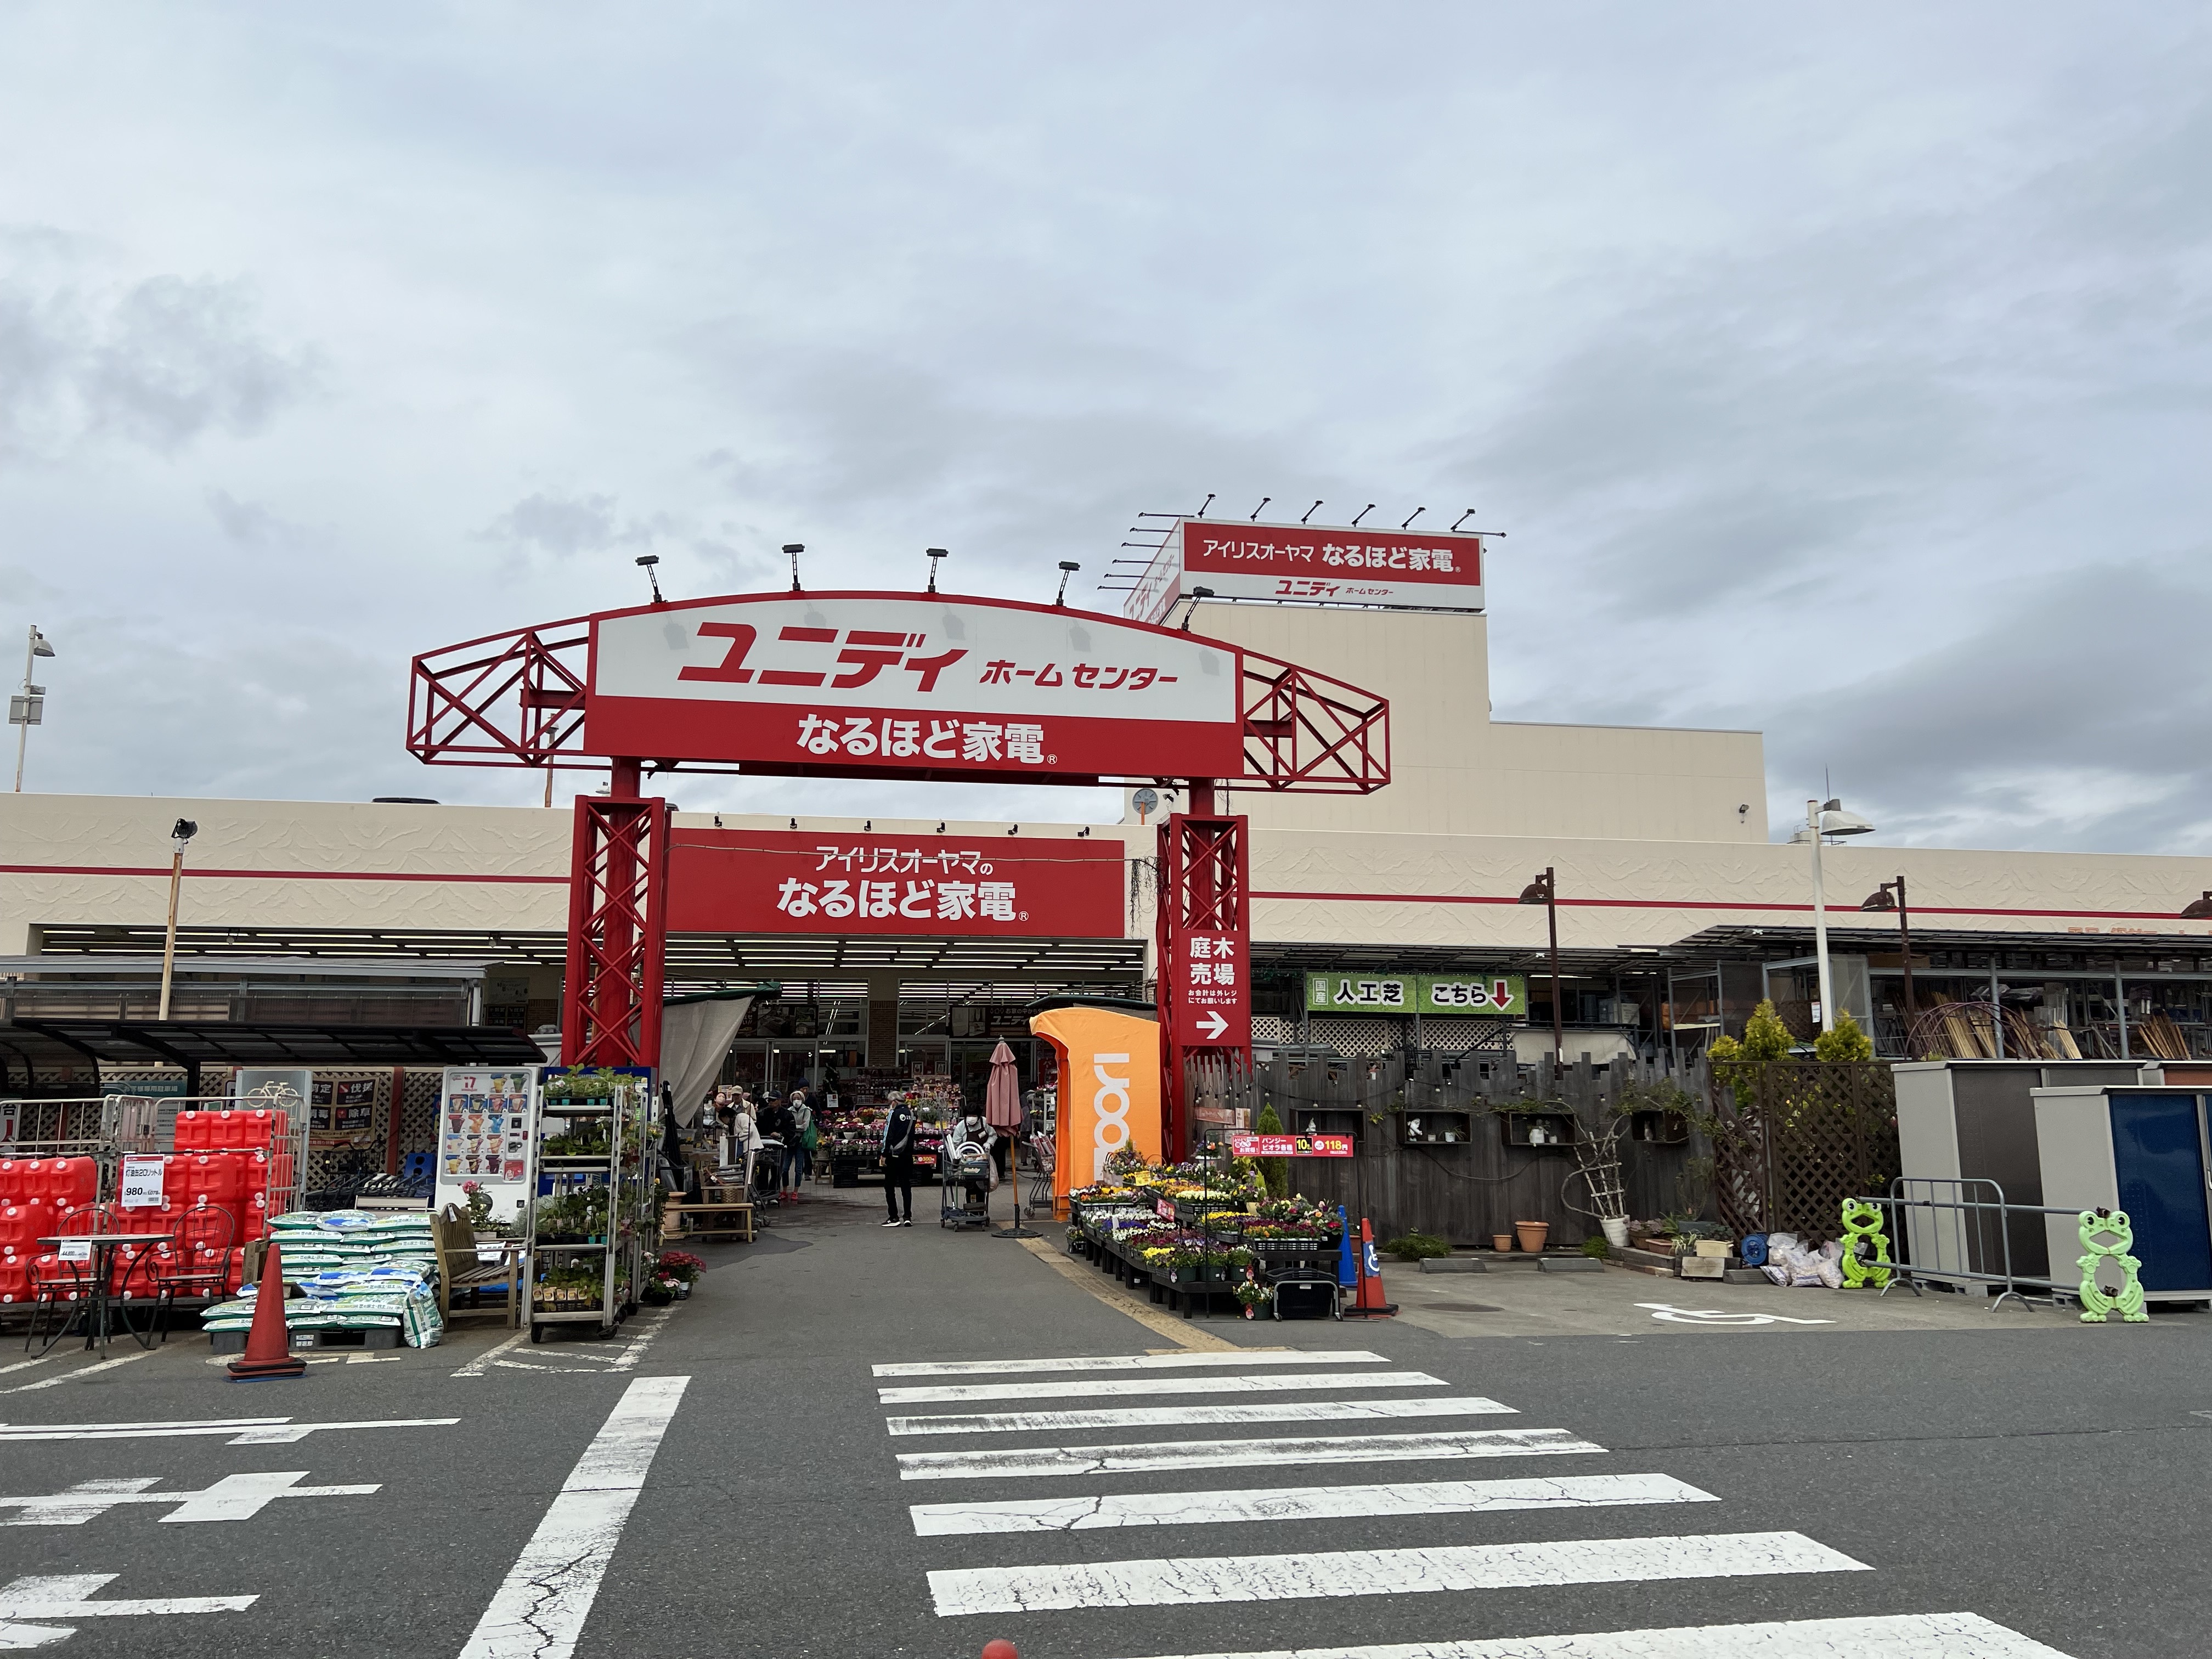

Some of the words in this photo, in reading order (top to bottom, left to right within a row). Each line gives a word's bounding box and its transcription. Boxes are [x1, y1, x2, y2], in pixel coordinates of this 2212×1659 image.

[1203, 540, 1314, 562] アイリスオーヤマ
[1275, 579, 1341, 597] ユニディ
[1345, 587, 1394, 596] ホームセンター
[678, 622, 968, 692] ユニディ
[979, 659, 1178, 691] ホームセンター
[815, 846, 994, 876] アイリスオーヤマの
[1189, 936, 1234, 959] 庭木
[1190, 962, 1235, 985] 売場
[1335, 981, 1402, 1005] 人工芝
[1432, 984, 1487, 1004] こちら
[990, 1015, 1030, 1025] ユニディ
